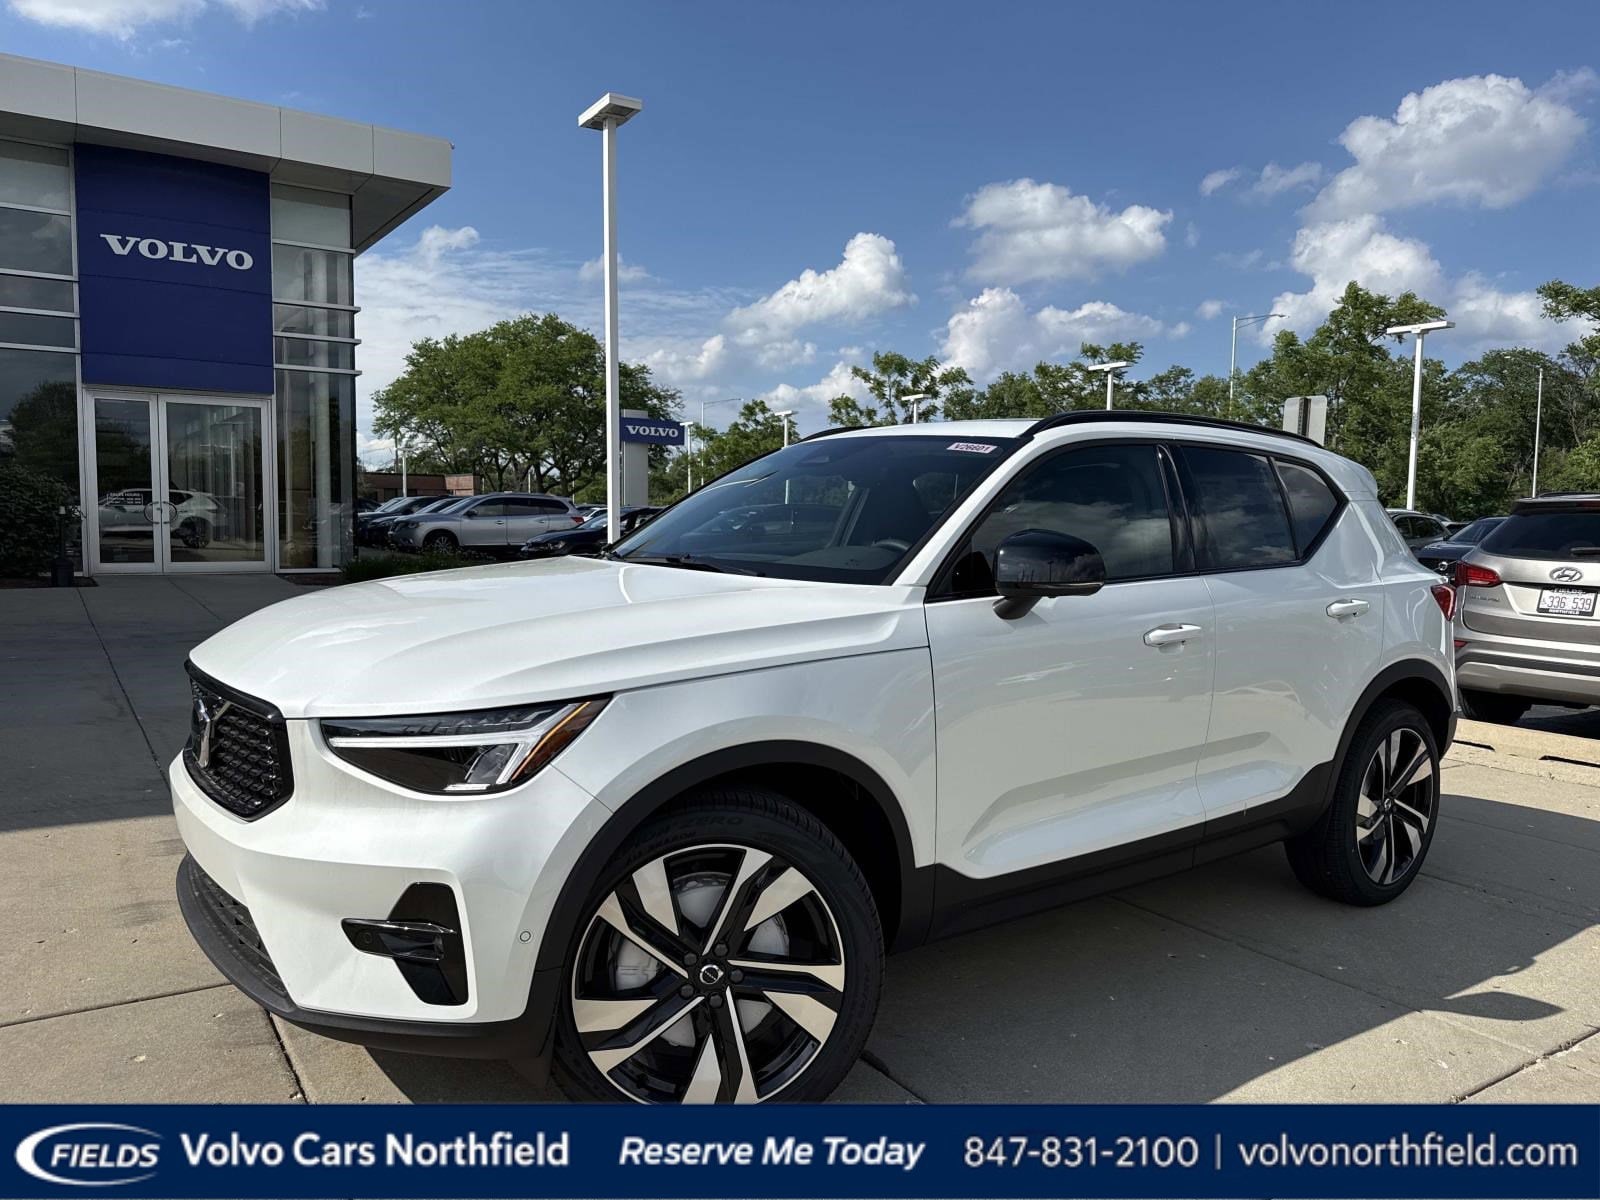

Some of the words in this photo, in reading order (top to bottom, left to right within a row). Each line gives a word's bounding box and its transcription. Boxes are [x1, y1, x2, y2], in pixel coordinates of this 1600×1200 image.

[100, 233, 254, 270] VOLVO
[625, 425, 679, 438] VOLVO
[1547, 595, 1567, 609] 336
[1571, 597, 1592, 611] 539
